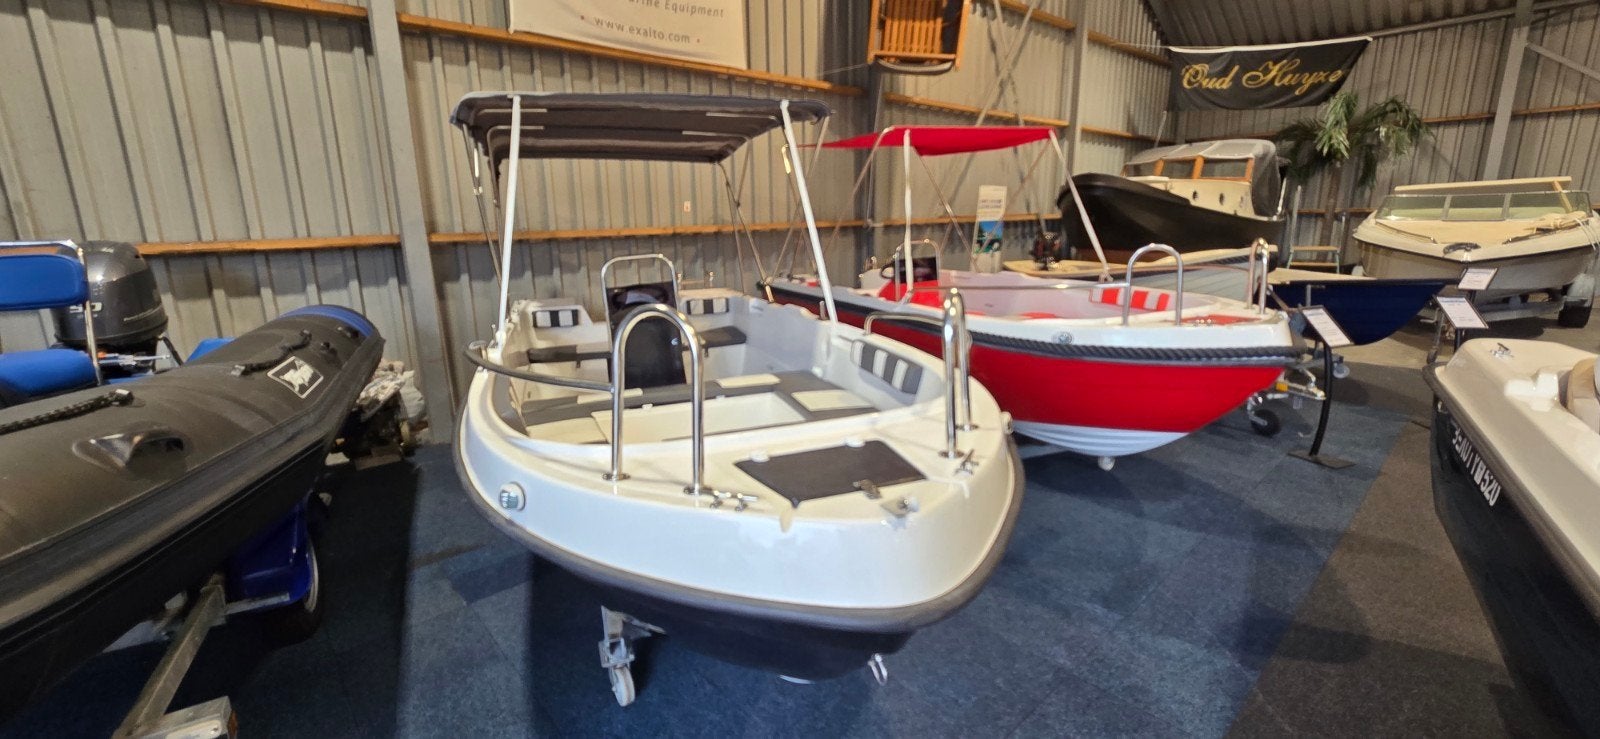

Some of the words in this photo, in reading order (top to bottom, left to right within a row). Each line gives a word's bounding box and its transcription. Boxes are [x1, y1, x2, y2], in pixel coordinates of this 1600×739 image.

[664, 0, 724, 17] Equipment
[594, 17, 690, 43] www.exalto.com
[1181, 63, 1240, 90] Oud
